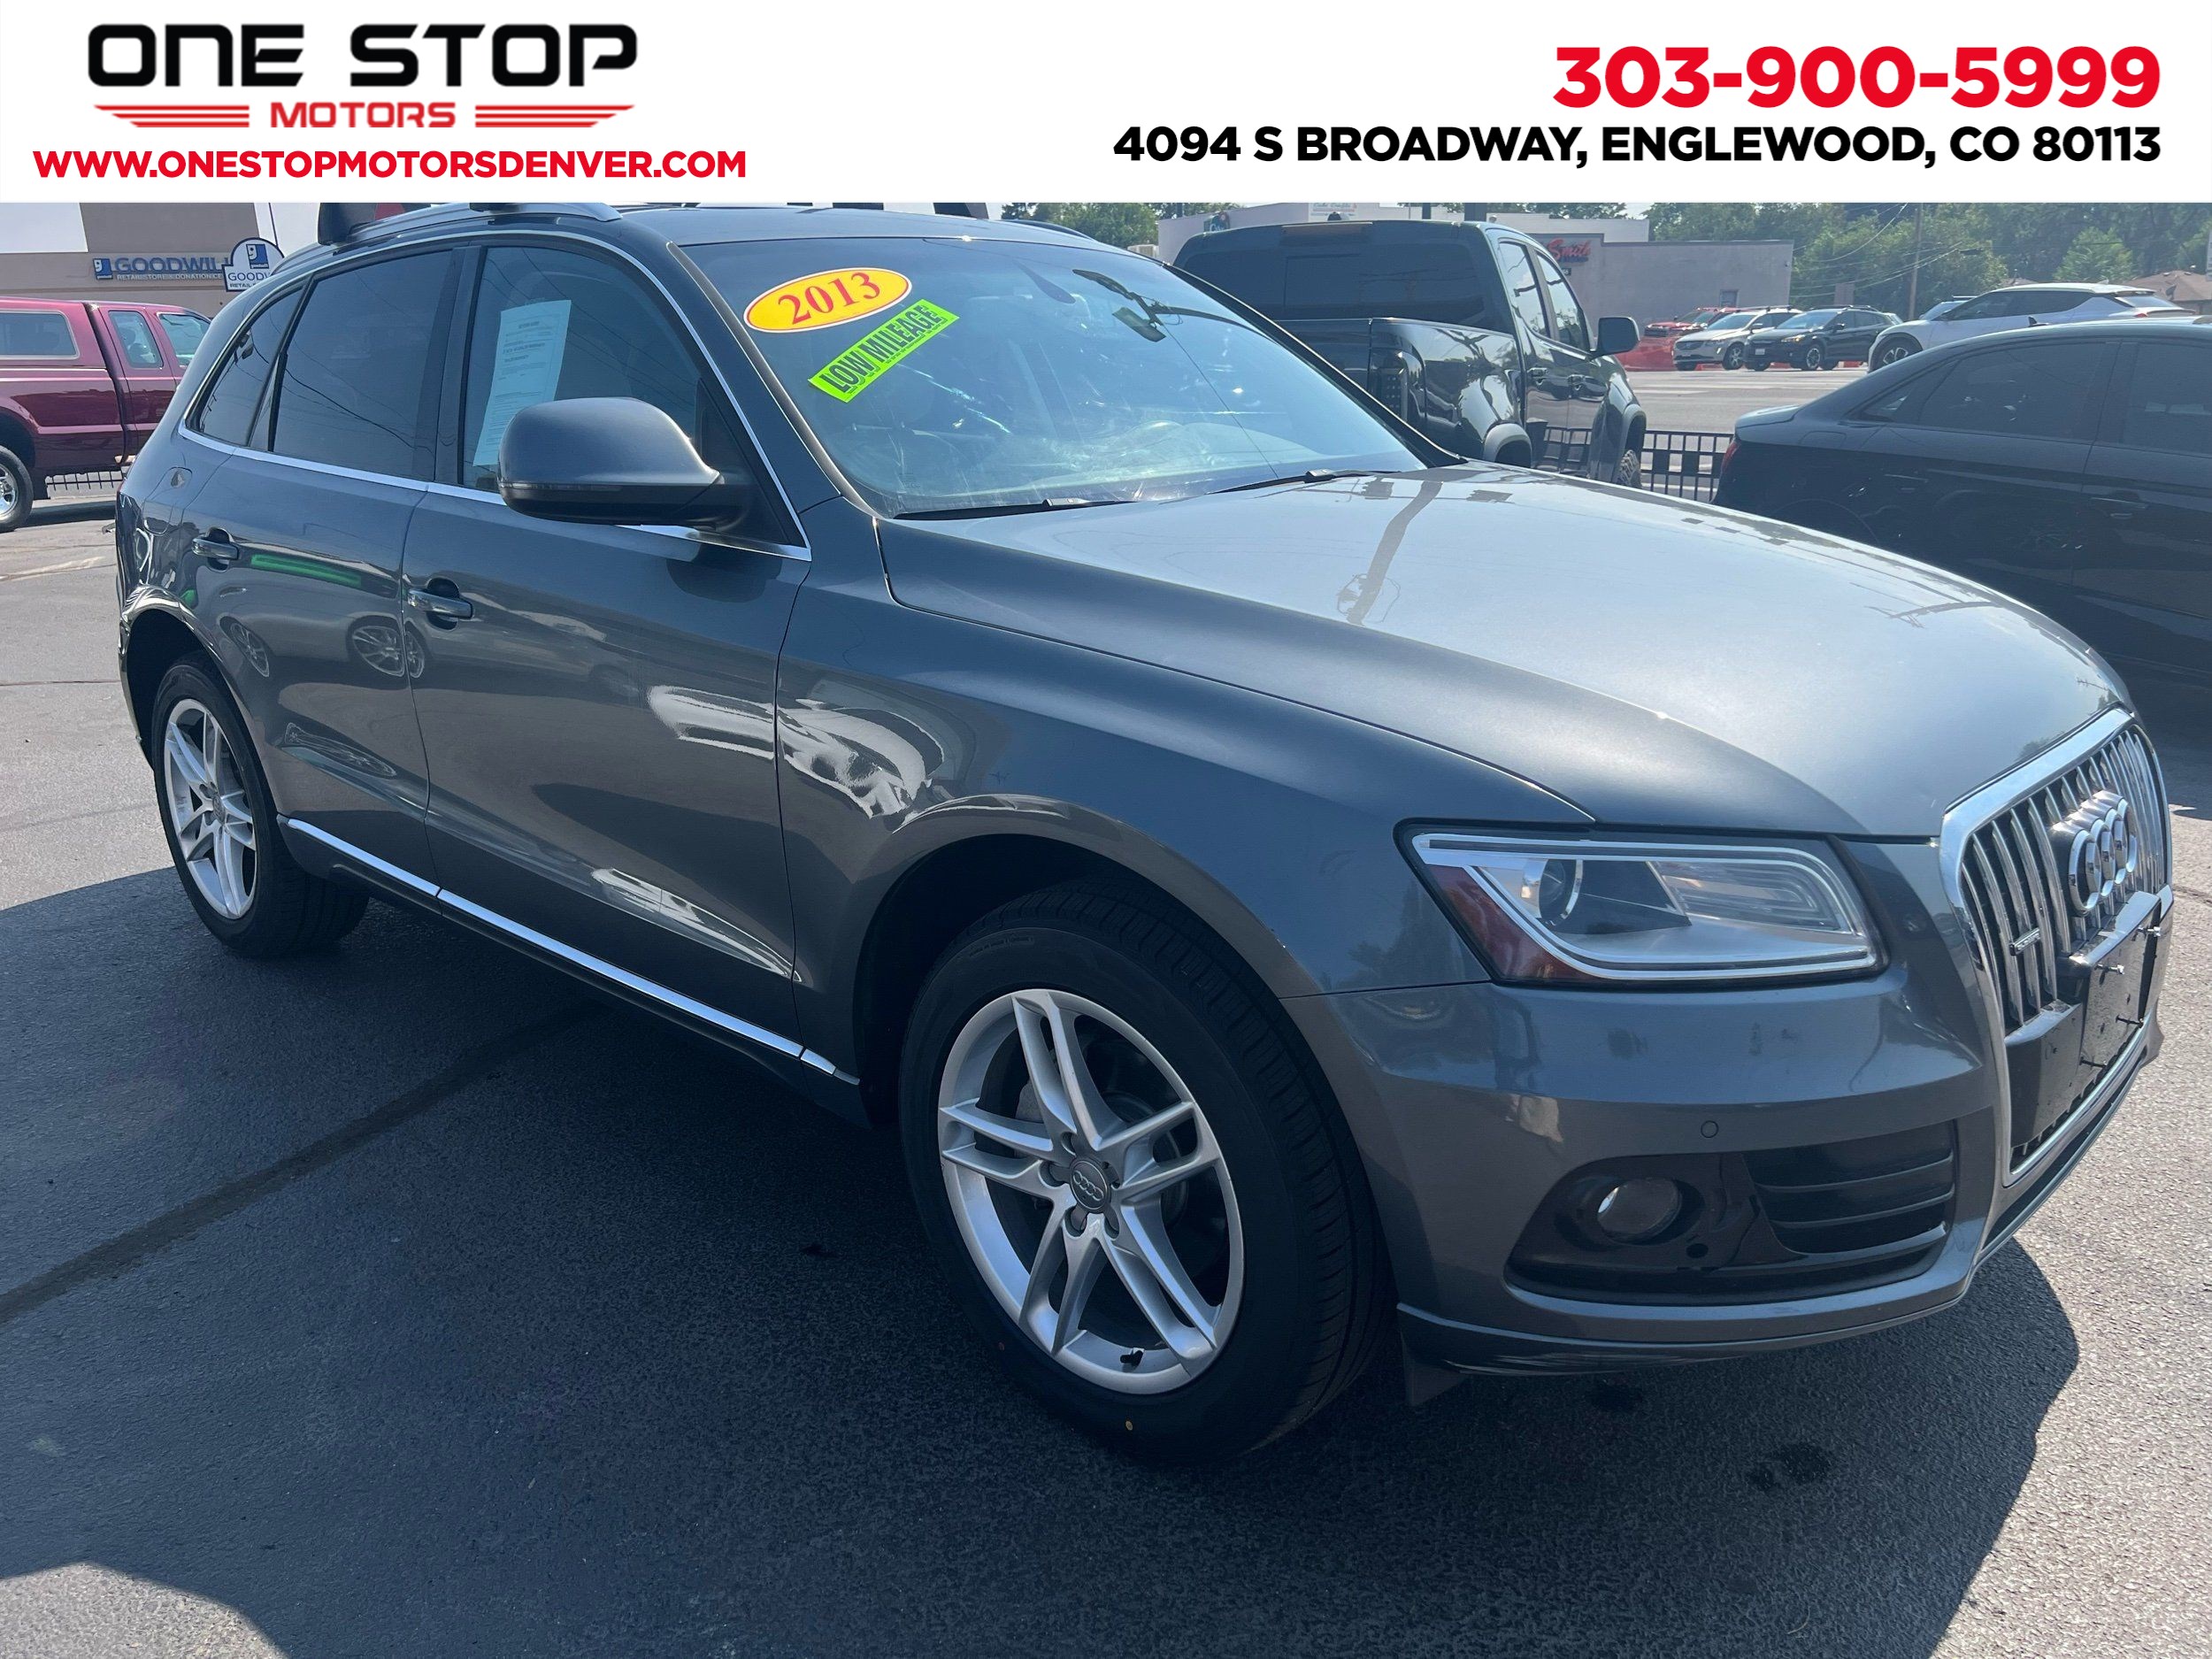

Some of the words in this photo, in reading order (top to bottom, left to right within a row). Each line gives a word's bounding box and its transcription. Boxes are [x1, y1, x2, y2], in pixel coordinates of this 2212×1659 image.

[778, 272, 880, 325] 2013
[819, 350, 879, 395] LOW
[858, 305, 948, 363] MILEAGE
